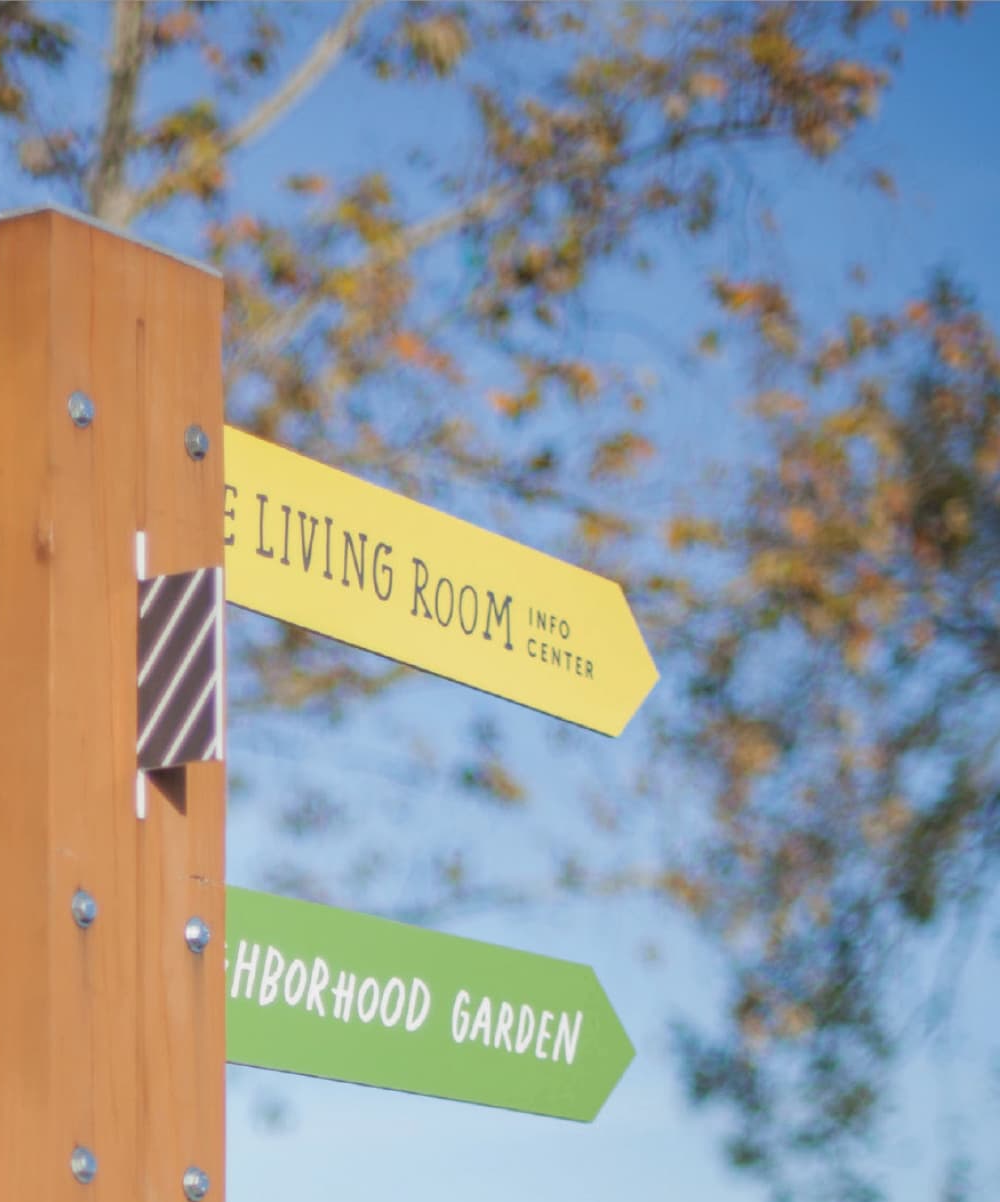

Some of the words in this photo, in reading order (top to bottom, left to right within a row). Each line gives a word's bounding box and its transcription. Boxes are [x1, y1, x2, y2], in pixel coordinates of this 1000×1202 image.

[255, 493, 394, 601] LIVING
[410, 557, 513, 651] ROOM
[527, 639, 595, 680] CENTER
[528, 607, 571, 640] INFO
[225, 939, 431, 1032] HBORHOOD
[451, 989, 583, 1065] GARDEN
